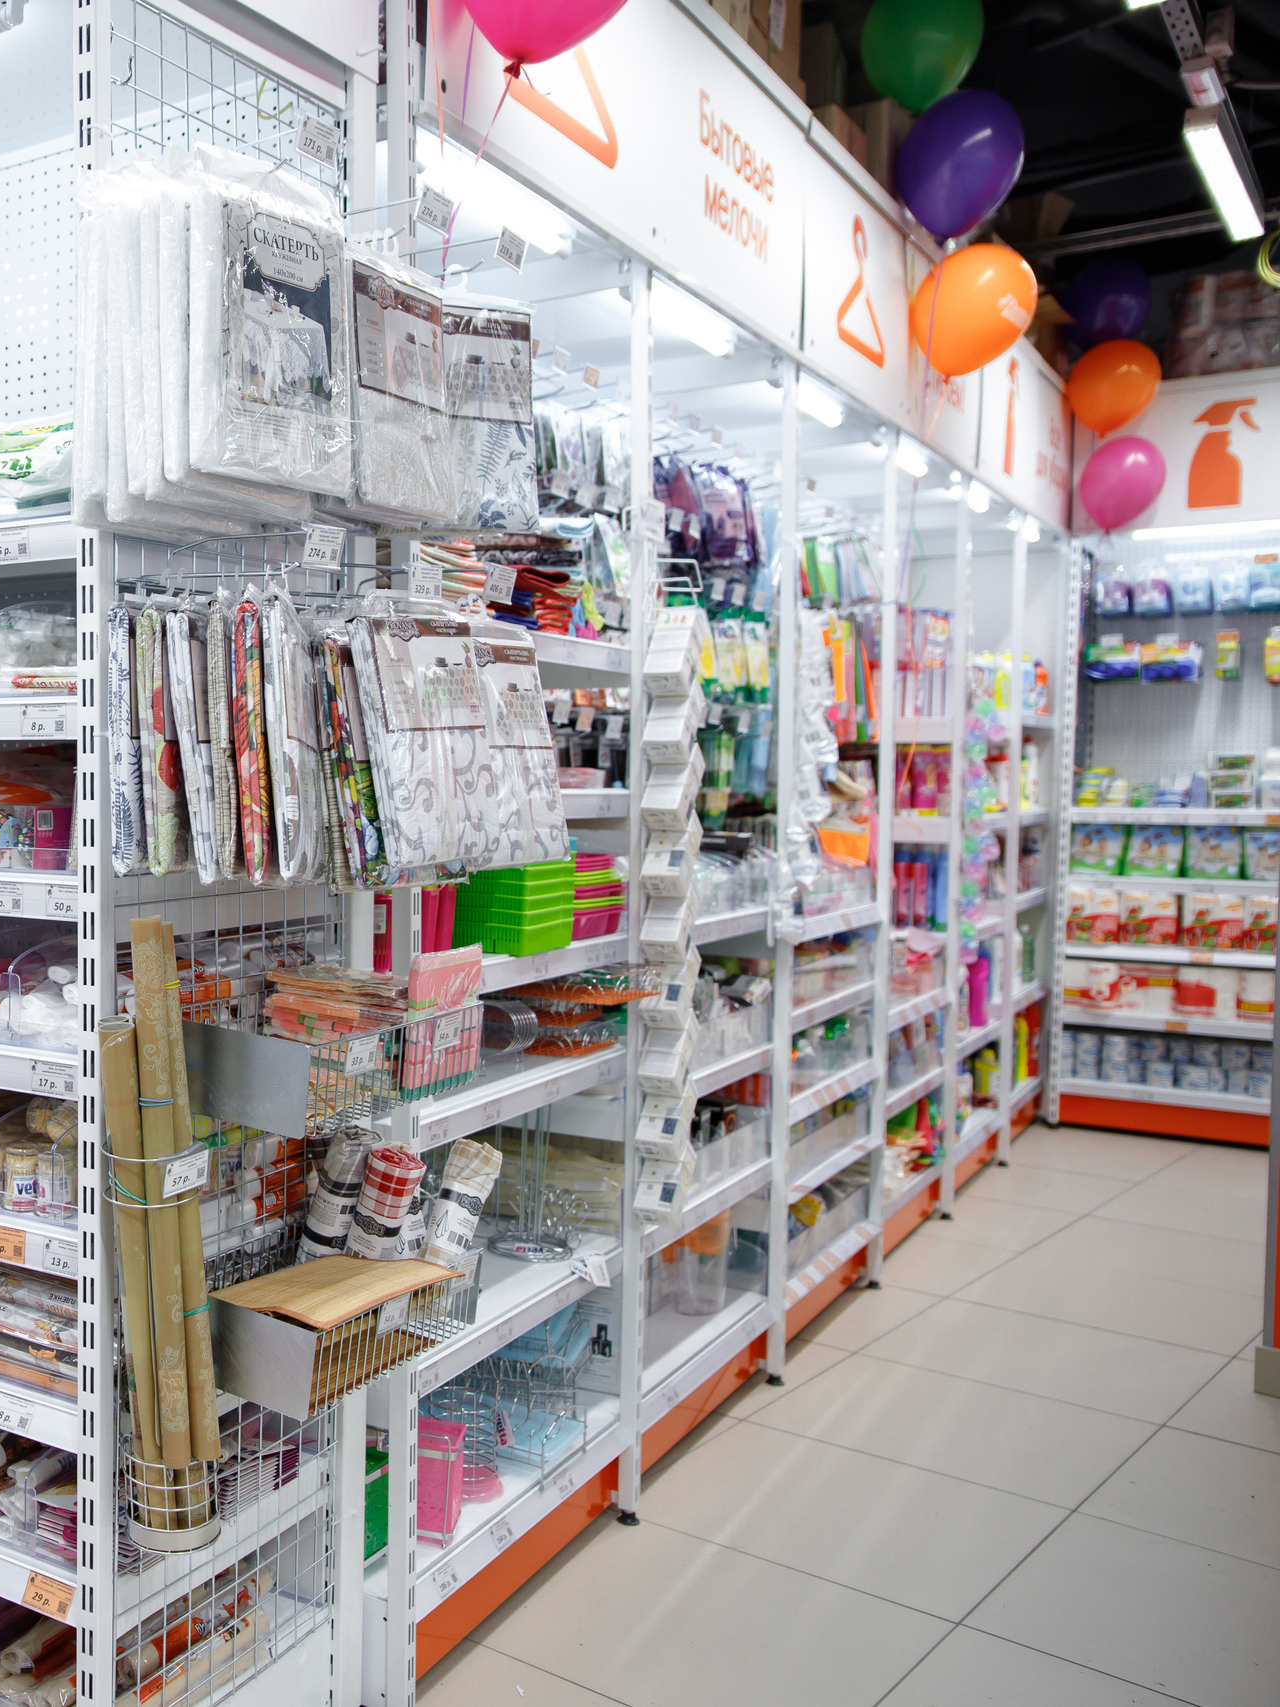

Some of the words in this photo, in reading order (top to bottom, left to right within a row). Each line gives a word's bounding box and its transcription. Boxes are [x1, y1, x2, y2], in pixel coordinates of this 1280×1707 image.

[303, 137, 316, 150] 171
[699, 87, 774, 203] Бытовые
[421, 206, 434, 220] 274
[704, 174, 768, 265] мелочи
[253, 227, 319, 261] СКАТЕРТЬ
[308, 548, 321, 559] 274
[414, 584, 426, 594] 329
[31, 721, 36, 731] 8
[54, 902, 63, 911] 50
[351, 1056, 359, 1066] 33
[39, 1078, 47, 1087] 17
[172, 1176, 181, 1187] 57
[51, 1257, 61, 1266] 13
[32, 1591, 42, 1600] 29
